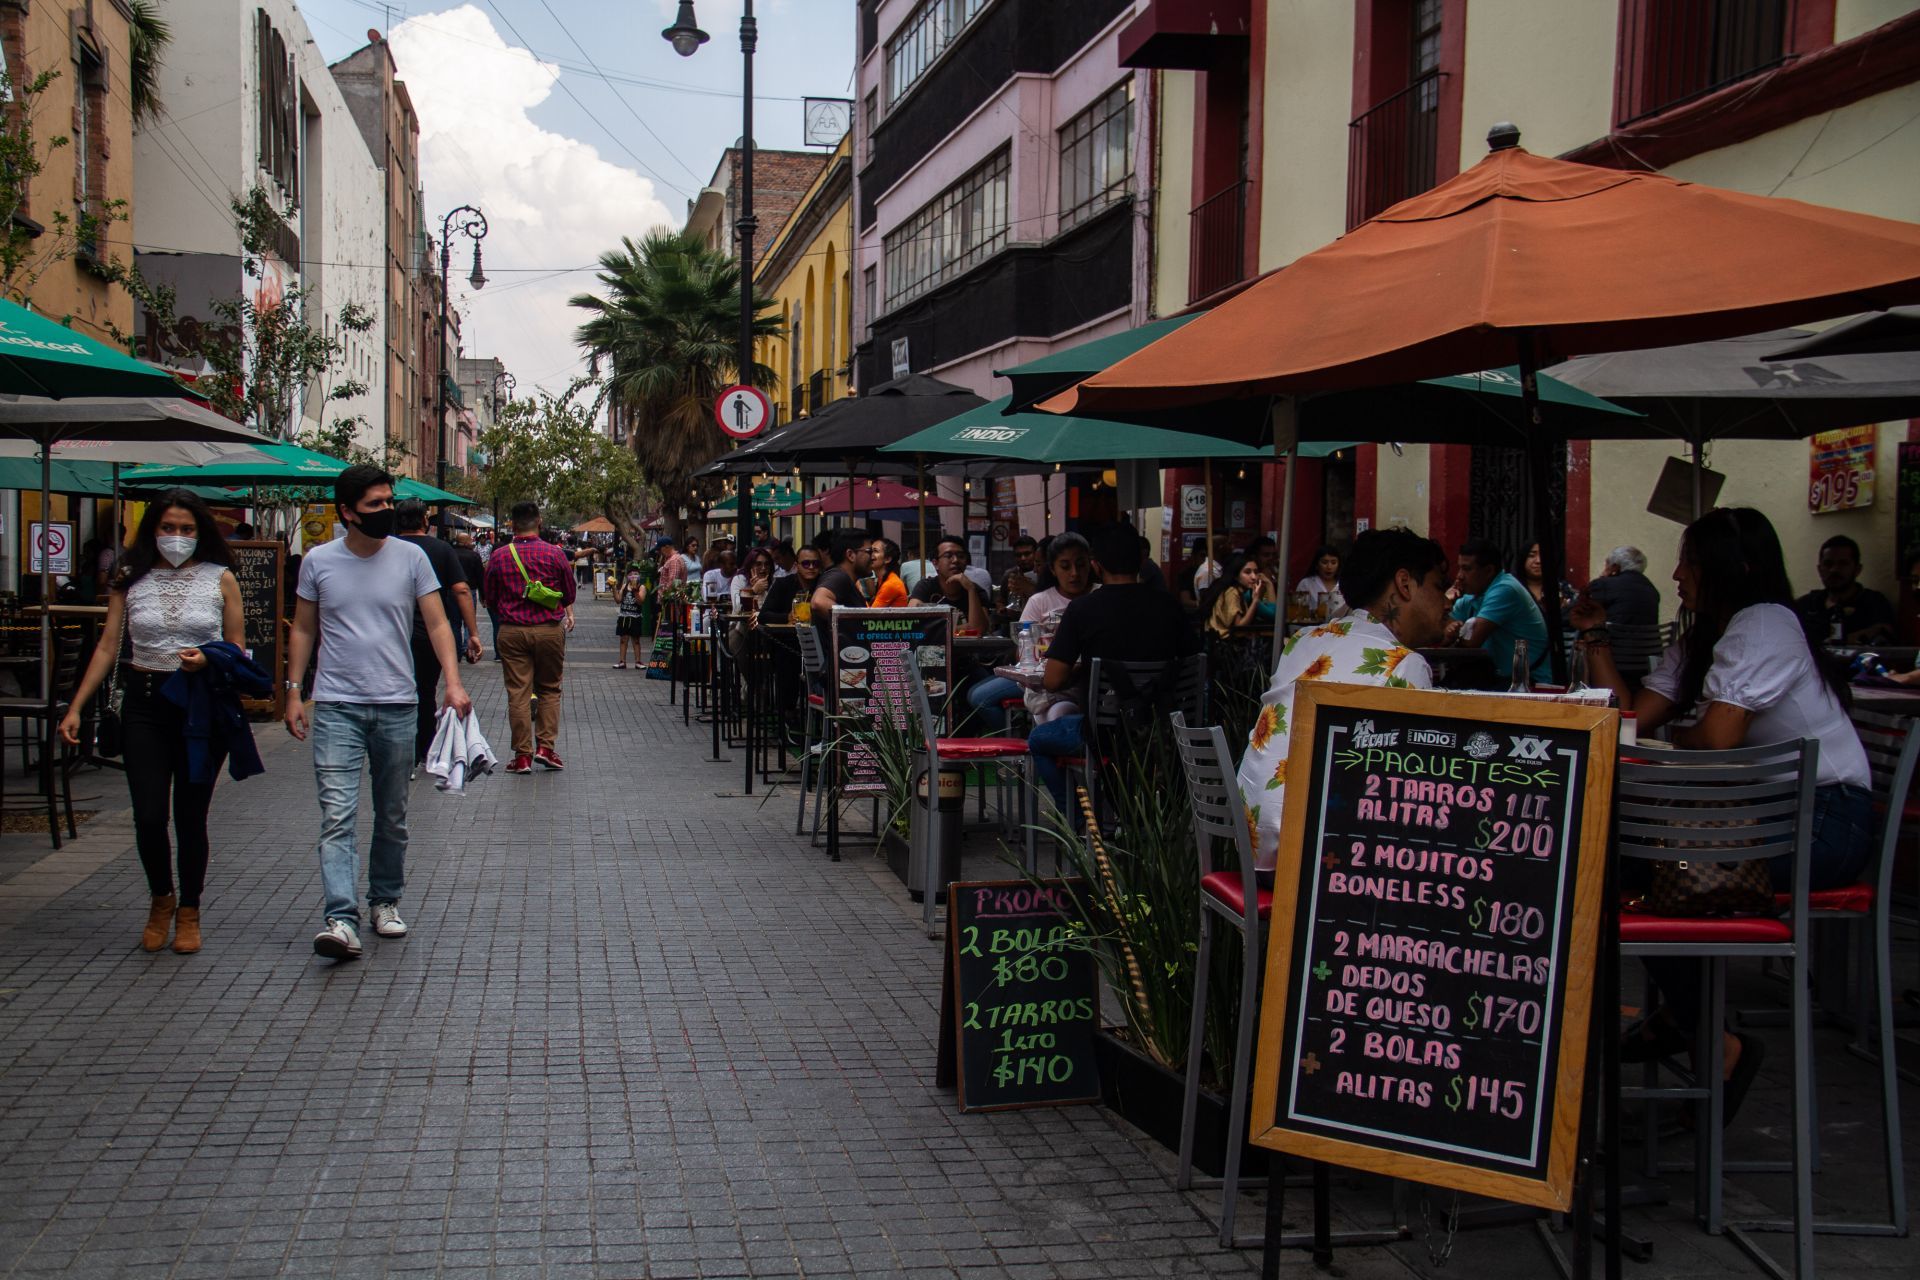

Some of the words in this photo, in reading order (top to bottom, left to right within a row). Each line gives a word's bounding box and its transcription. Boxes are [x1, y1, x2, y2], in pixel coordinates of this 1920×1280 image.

[961, 428, 1016, 441] INDIO
[1810, 469, 1860, 508] $195
[235, 571, 268, 579] ARRIL
[1351, 731, 1400, 749] TECATE
[1413, 731, 1450, 745] INDIO
[1365, 749, 1532, 785] PAQUETES
[1365, 774, 1380, 797] 2
[1386, 776, 1496, 813] TARROS
[1357, 798, 1450, 831] ALITAS
[1474, 817, 1554, 858] $200
[1351, 841, 1367, 867] 2
[1374, 843, 1494, 882] MOJITOS
[973, 888, 1073, 913] PROMO
[1328, 872, 1466, 910] BONELESS
[1468, 896, 1545, 940] $180
[960, 926, 983, 957] 2
[989, 926, 1074, 954] BOLA
[1333, 931, 1350, 956] 2
[1357, 932, 1551, 985] MARGACHELAS
[992, 956, 1069, 987] $80
[1341, 964, 1427, 998] DEDOS
[963, 1002, 983, 1029] 2
[985, 998, 1094, 1028] TARROS
[1326, 989, 1359, 1016] DE
[1366, 996, 1451, 1031] QUESO
[1462, 990, 1541, 1034] $170
[1329, 1028, 1346, 1054] 2
[1363, 1031, 1462, 1070] BOLAS
[993, 1055, 1074, 1088] $140
[1336, 1071, 1433, 1108] ALITAS
[1444, 1074, 1527, 1119] $145
